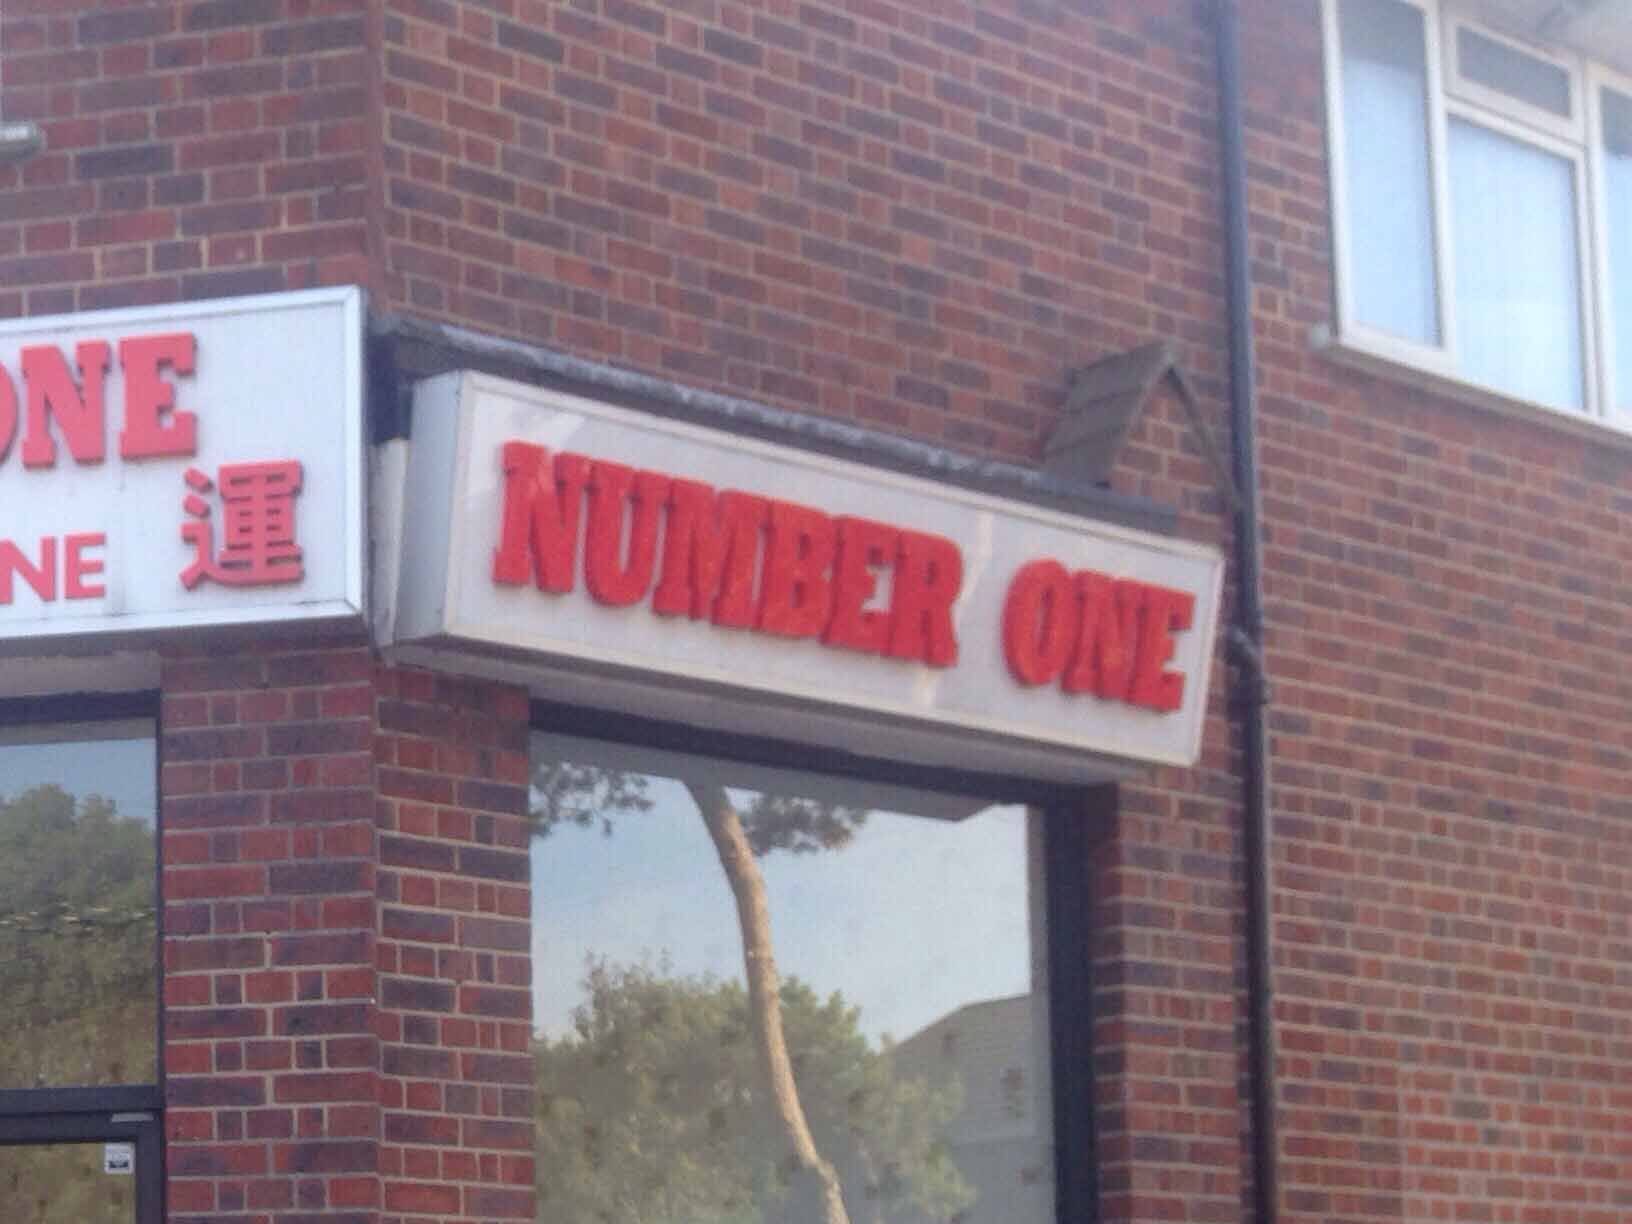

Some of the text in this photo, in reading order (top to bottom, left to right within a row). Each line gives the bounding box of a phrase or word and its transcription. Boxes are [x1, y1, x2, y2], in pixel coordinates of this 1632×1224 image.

[179, 459, 303, 590] 運
[491, 440, 1196, 712] NUMBER ONE
